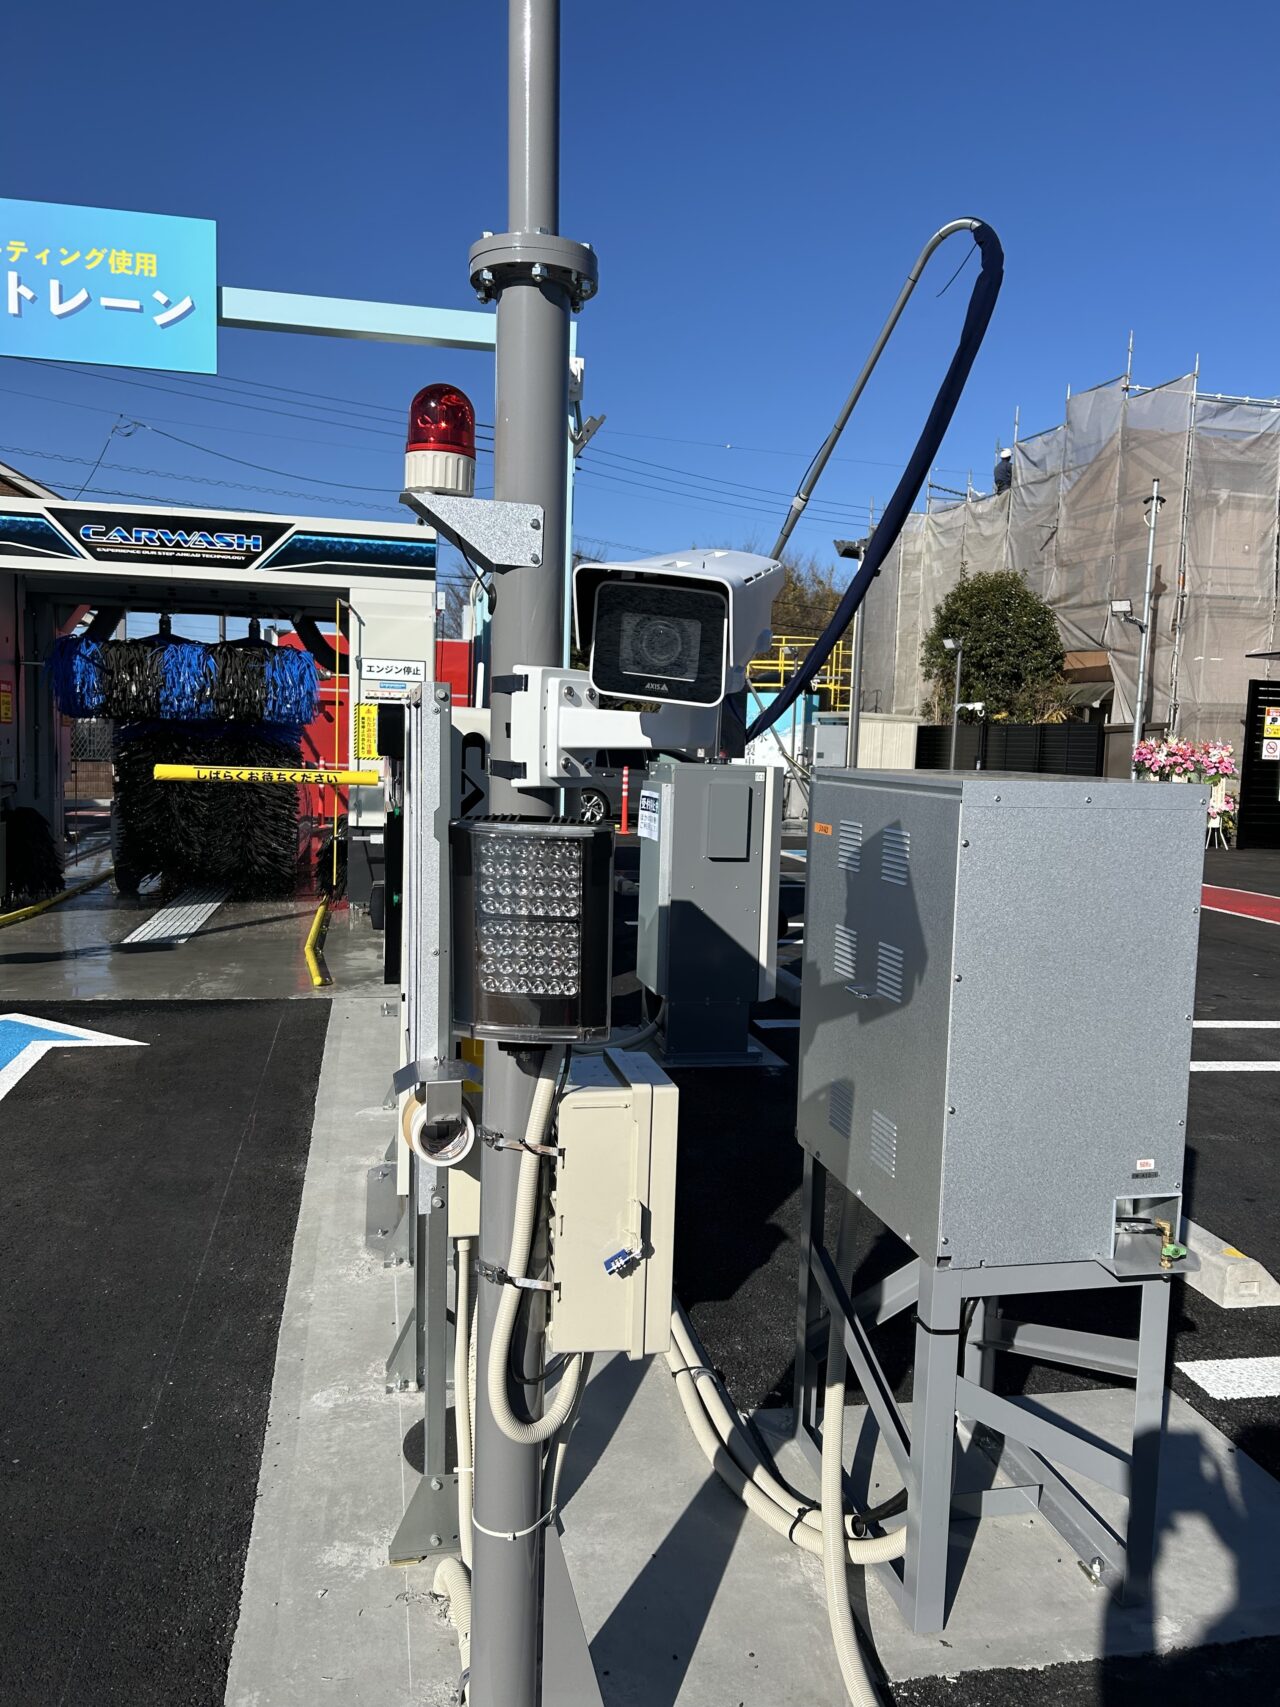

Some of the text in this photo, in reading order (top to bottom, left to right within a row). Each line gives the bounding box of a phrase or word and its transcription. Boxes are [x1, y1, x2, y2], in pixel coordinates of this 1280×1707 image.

[0, 240, 158, 278] ティング使用
[80, 524, 262, 552] CARWASH
[96, 547, 141, 555] EXPERIENCE
[366, 665, 421, 676] エンジン停止
[196, 769, 338, 784] しばらくお待ちください
